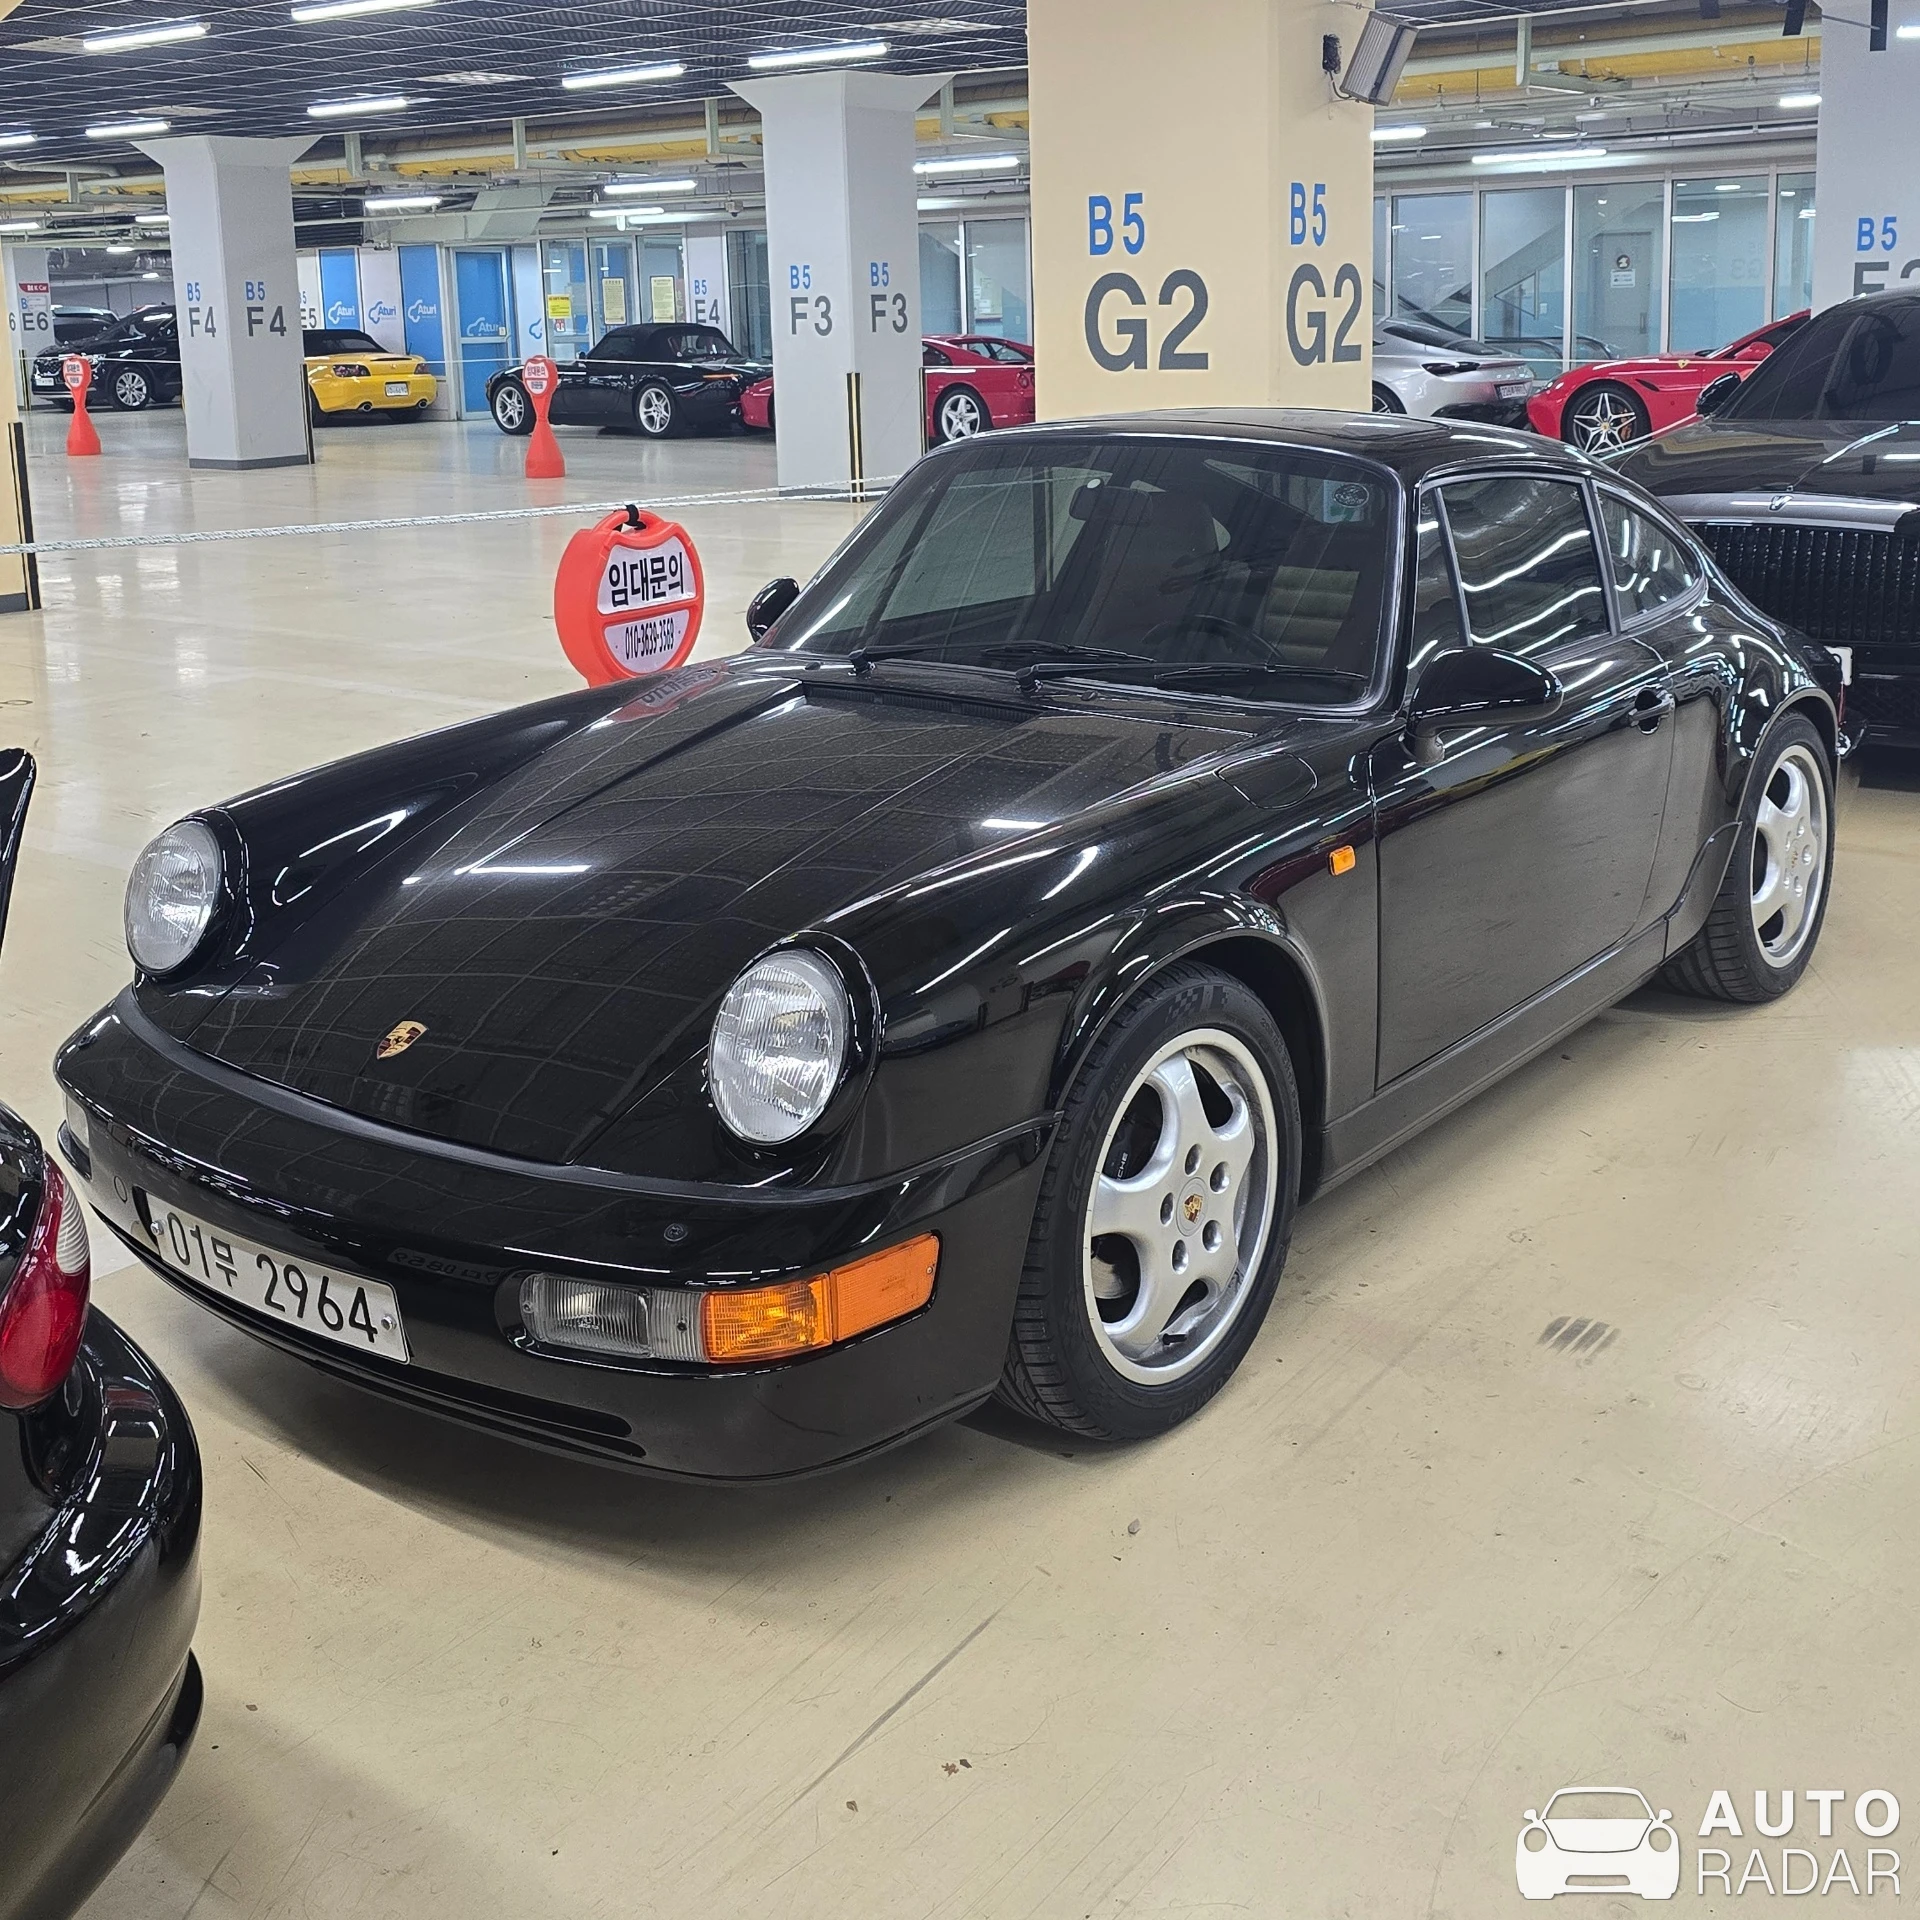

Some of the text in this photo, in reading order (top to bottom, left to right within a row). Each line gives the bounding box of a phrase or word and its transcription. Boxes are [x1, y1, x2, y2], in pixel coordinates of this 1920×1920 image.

[1088, 192, 1144, 255] B5
[1290, 182, 1327, 247] B5
[1857, 216, 1897, 251] B5
[245, 281, 265, 300] B5
[694, 279, 708, 295] B5
[789, 264, 812, 290] B5
[870, 262, 889, 287] B5
[1853, 259, 1920, 296] F
[187, 282, 201, 301] B5
[22, 311, 49, 331] E6
[188, 306, 216, 337] F4
[246, 305, 287, 337] F4
[478, 322, 499, 332] Atur
[695, 299, 720, 324] E4
[790, 295, 833, 337] F3
[871, 293, 908, 334] F3
[1084, 268, 1209, 372] G2
[1286, 263, 1362, 367] G2
[608, 551, 684, 608] 임대문의
[166, 1211, 379, 1344] 01무 2964
